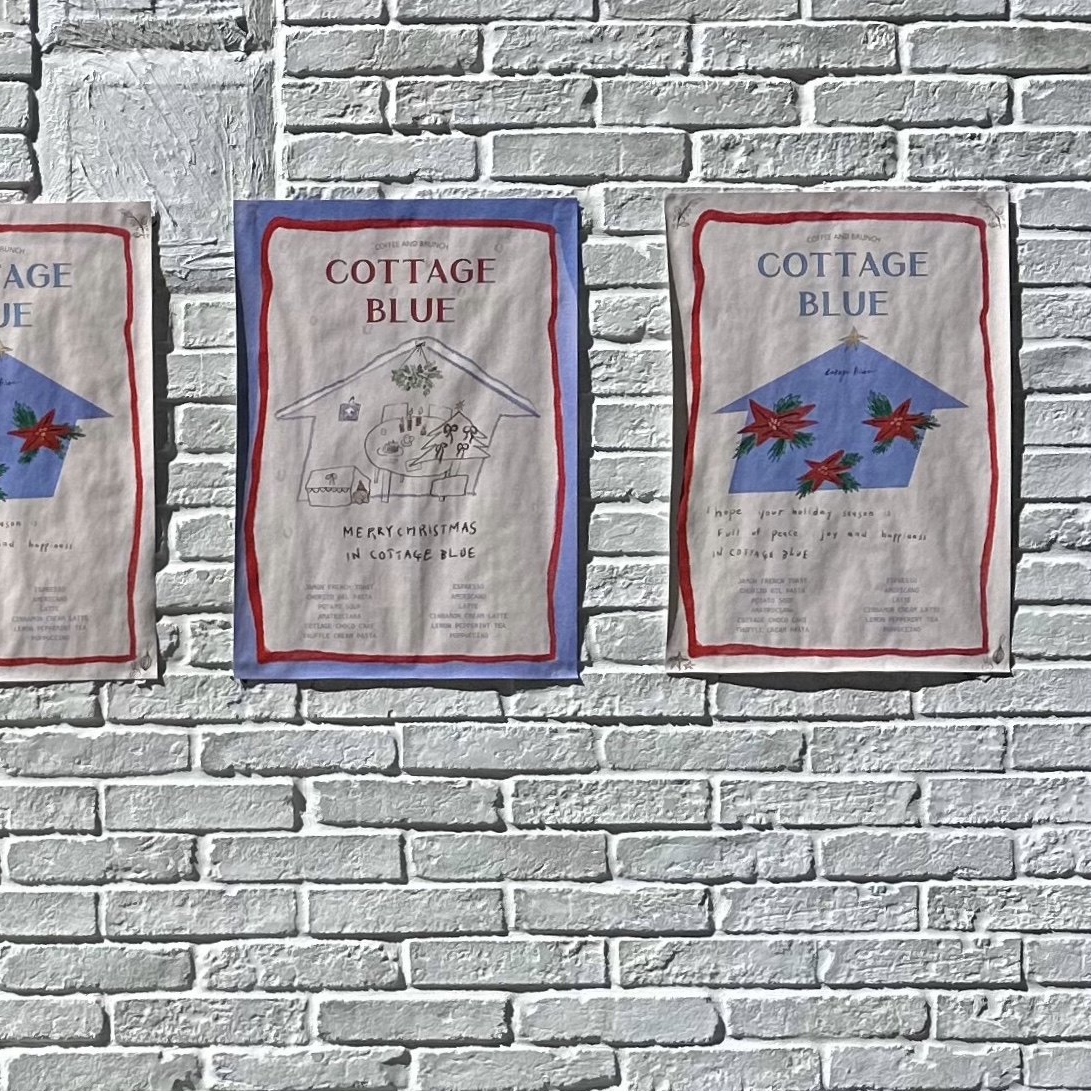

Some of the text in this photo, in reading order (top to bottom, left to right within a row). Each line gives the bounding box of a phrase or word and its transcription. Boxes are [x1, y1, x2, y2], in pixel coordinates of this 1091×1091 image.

[375, 242, 399, 250] COFFEE
[419, 241, 449, 250] BRUNCH
[807, 234, 831, 243] COFFEE
[851, 233, 881, 242] BRUNCH
[326, 258, 496, 284] COTTAGE
[758, 252, 928, 278] COTTAGE
[367, 298, 455, 323] BLUE
[799, 291, 888, 316] BLUE
[715, 508, 742, 521] hope
[758, 509, 784, 519] your
[791, 509, 833, 521] holiday
[343, 521, 477, 540] MERRY CHRISTMAS
[771, 529, 798, 542] peace
[820, 530, 838, 541] joy
[847, 530, 867, 539] and
[346, 547, 476, 562] IN COTTAGE BLUE
[712, 547, 808, 561] IN COTTAGE BLUE
